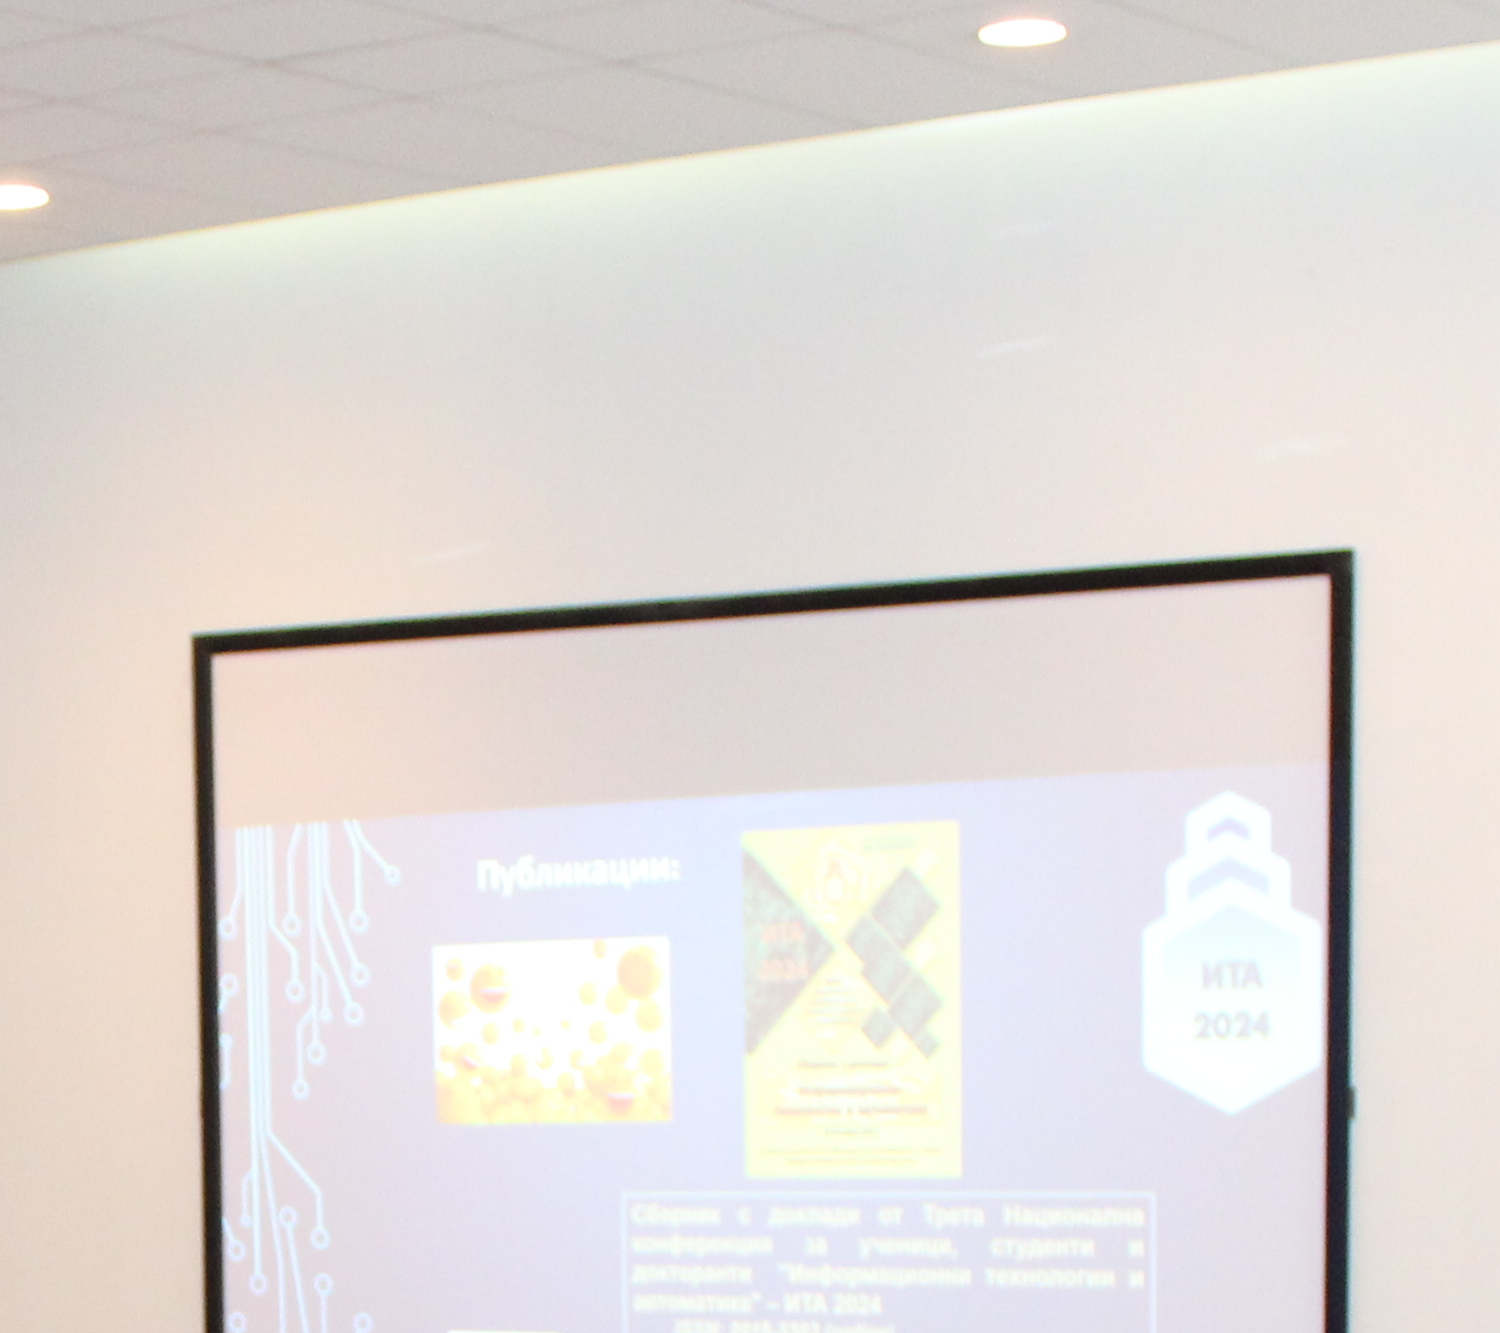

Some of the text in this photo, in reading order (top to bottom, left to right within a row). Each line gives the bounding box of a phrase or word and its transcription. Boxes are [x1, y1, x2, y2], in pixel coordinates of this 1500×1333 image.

[476, 854, 682, 899] Публикации:
[1201, 960, 1264, 990] ИТА
[1193, 1010, 1270, 1040] 2024
